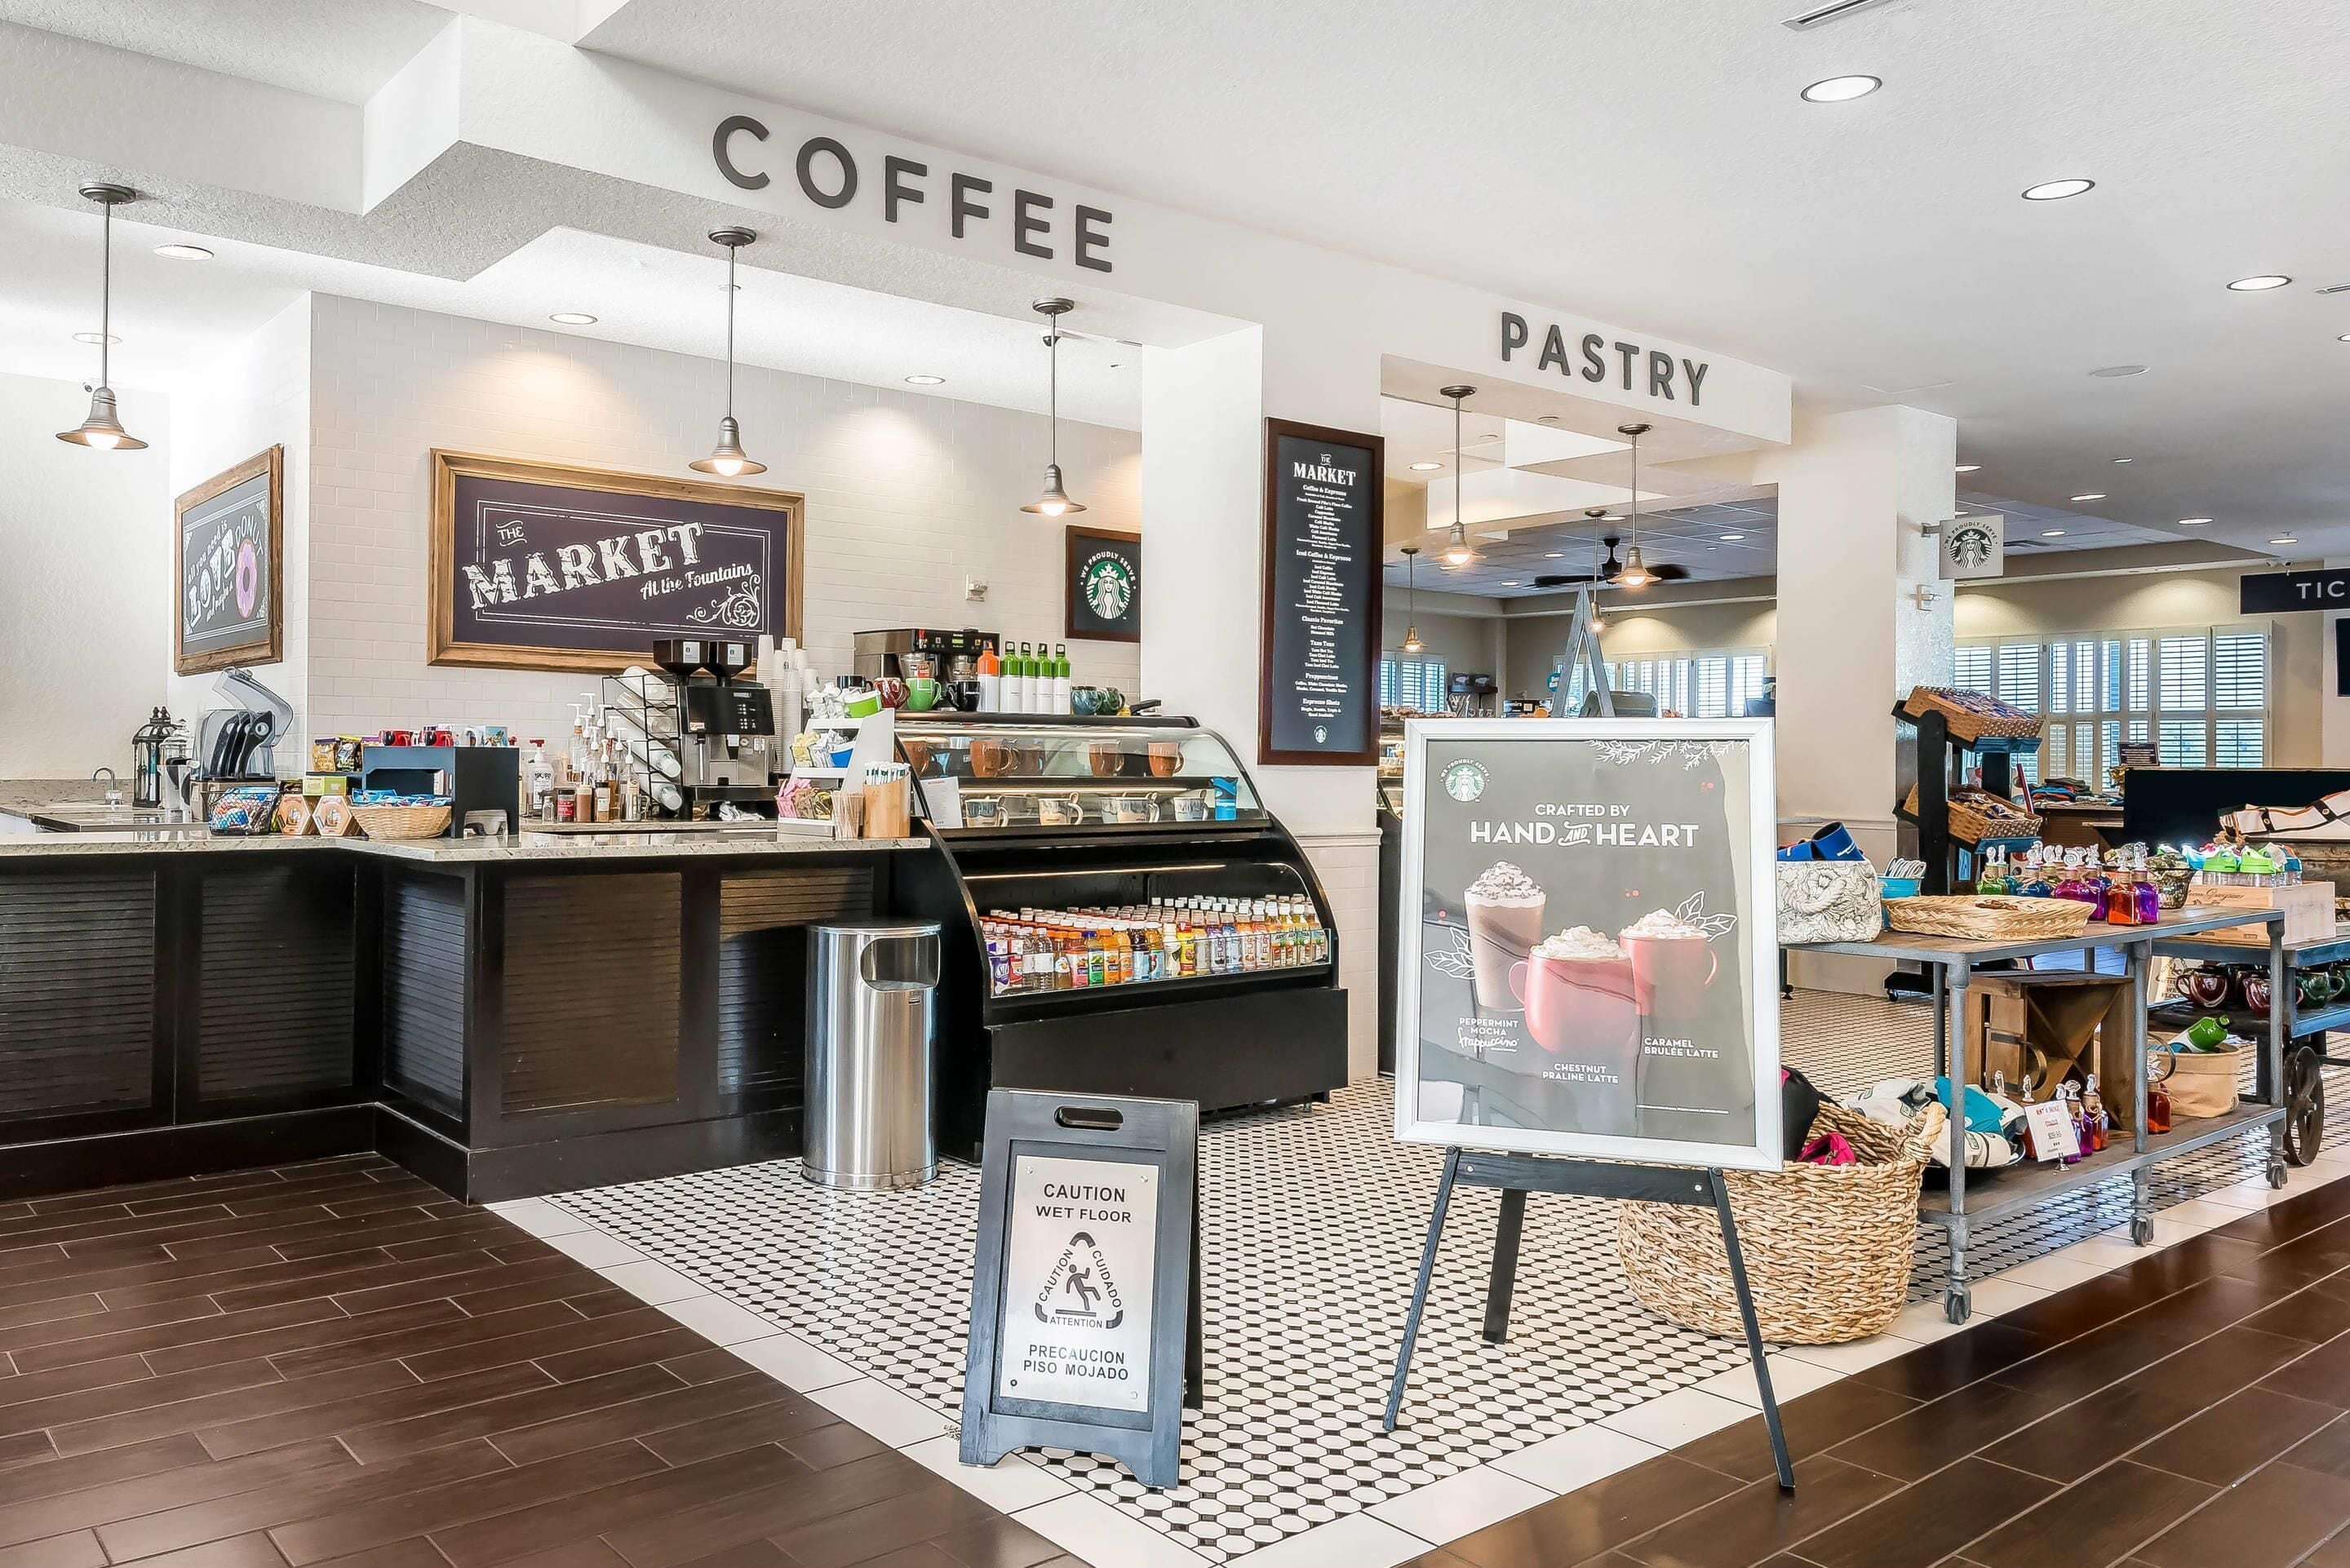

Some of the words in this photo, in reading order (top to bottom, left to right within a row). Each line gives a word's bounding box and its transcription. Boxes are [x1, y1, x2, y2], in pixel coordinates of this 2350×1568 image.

[712, 114, 1113, 272] COFFEE
[1501, 312, 1709, 405] PASTRY
[1293, 462, 1356, 486] MARKET
[235, 515, 264, 556] DONUT
[497, 524, 525, 542] THE
[1944, 535, 1952, 544] WE
[1951, 521, 1980, 534] PROUDLY
[1982, 524, 1998, 538] SERVE
[196, 551, 207, 576] you
[207, 526, 221, 556] need
[221, 520, 228, 534] is
[462, 522, 705, 610] MARKET
[1080, 565, 1089, 578] WE
[1088, 551, 1120, 565] PROUDLY
[1120, 557, 1137, 582] SERVE
[188, 529, 236, 628] LOVE
[640, 580, 660, 600] At
[662, 576, 683, 595] the
[685, 562, 754, 588] Fountains
[2296, 580, 2345, 600] TIC
[1534, 804, 1606, 817] CRAFTED
[1609, 804, 1630, 817] BY
[1470, 821, 1556, 845] HAND
[1562, 823, 1590, 844] AND
[1596, 823, 1700, 848] HEART
[1459, 1017, 1519, 1029] PEPPERMINT
[1470, 1026, 1508, 1036] MOCHA
[1644, 1037, 1694, 1048] CARAMEL
[1687, 1048, 1719, 1060] LATTE
[1542, 1071, 1585, 1083] PRALINE
[1587, 1074, 1619, 1085] LATTE
[1554, 1063, 1607, 1074] CHESTNUT
[1044, 1183, 1125, 1203] CAUTION
[1035, 1205, 1075, 1219] WET
[1080, 1208, 1132, 1223] FLOOR
[1039, 1248, 1075, 1303] CAUTION
[1093, 1250, 1122, 1309] CUIDADO
[1049, 1316, 1103, 1329] ATTENTION
[1029, 1344, 1124, 1365] PRECAUCION
[1023, 1359, 1058, 1375] PISO
[1065, 1363, 1128, 1380] MOJADO
